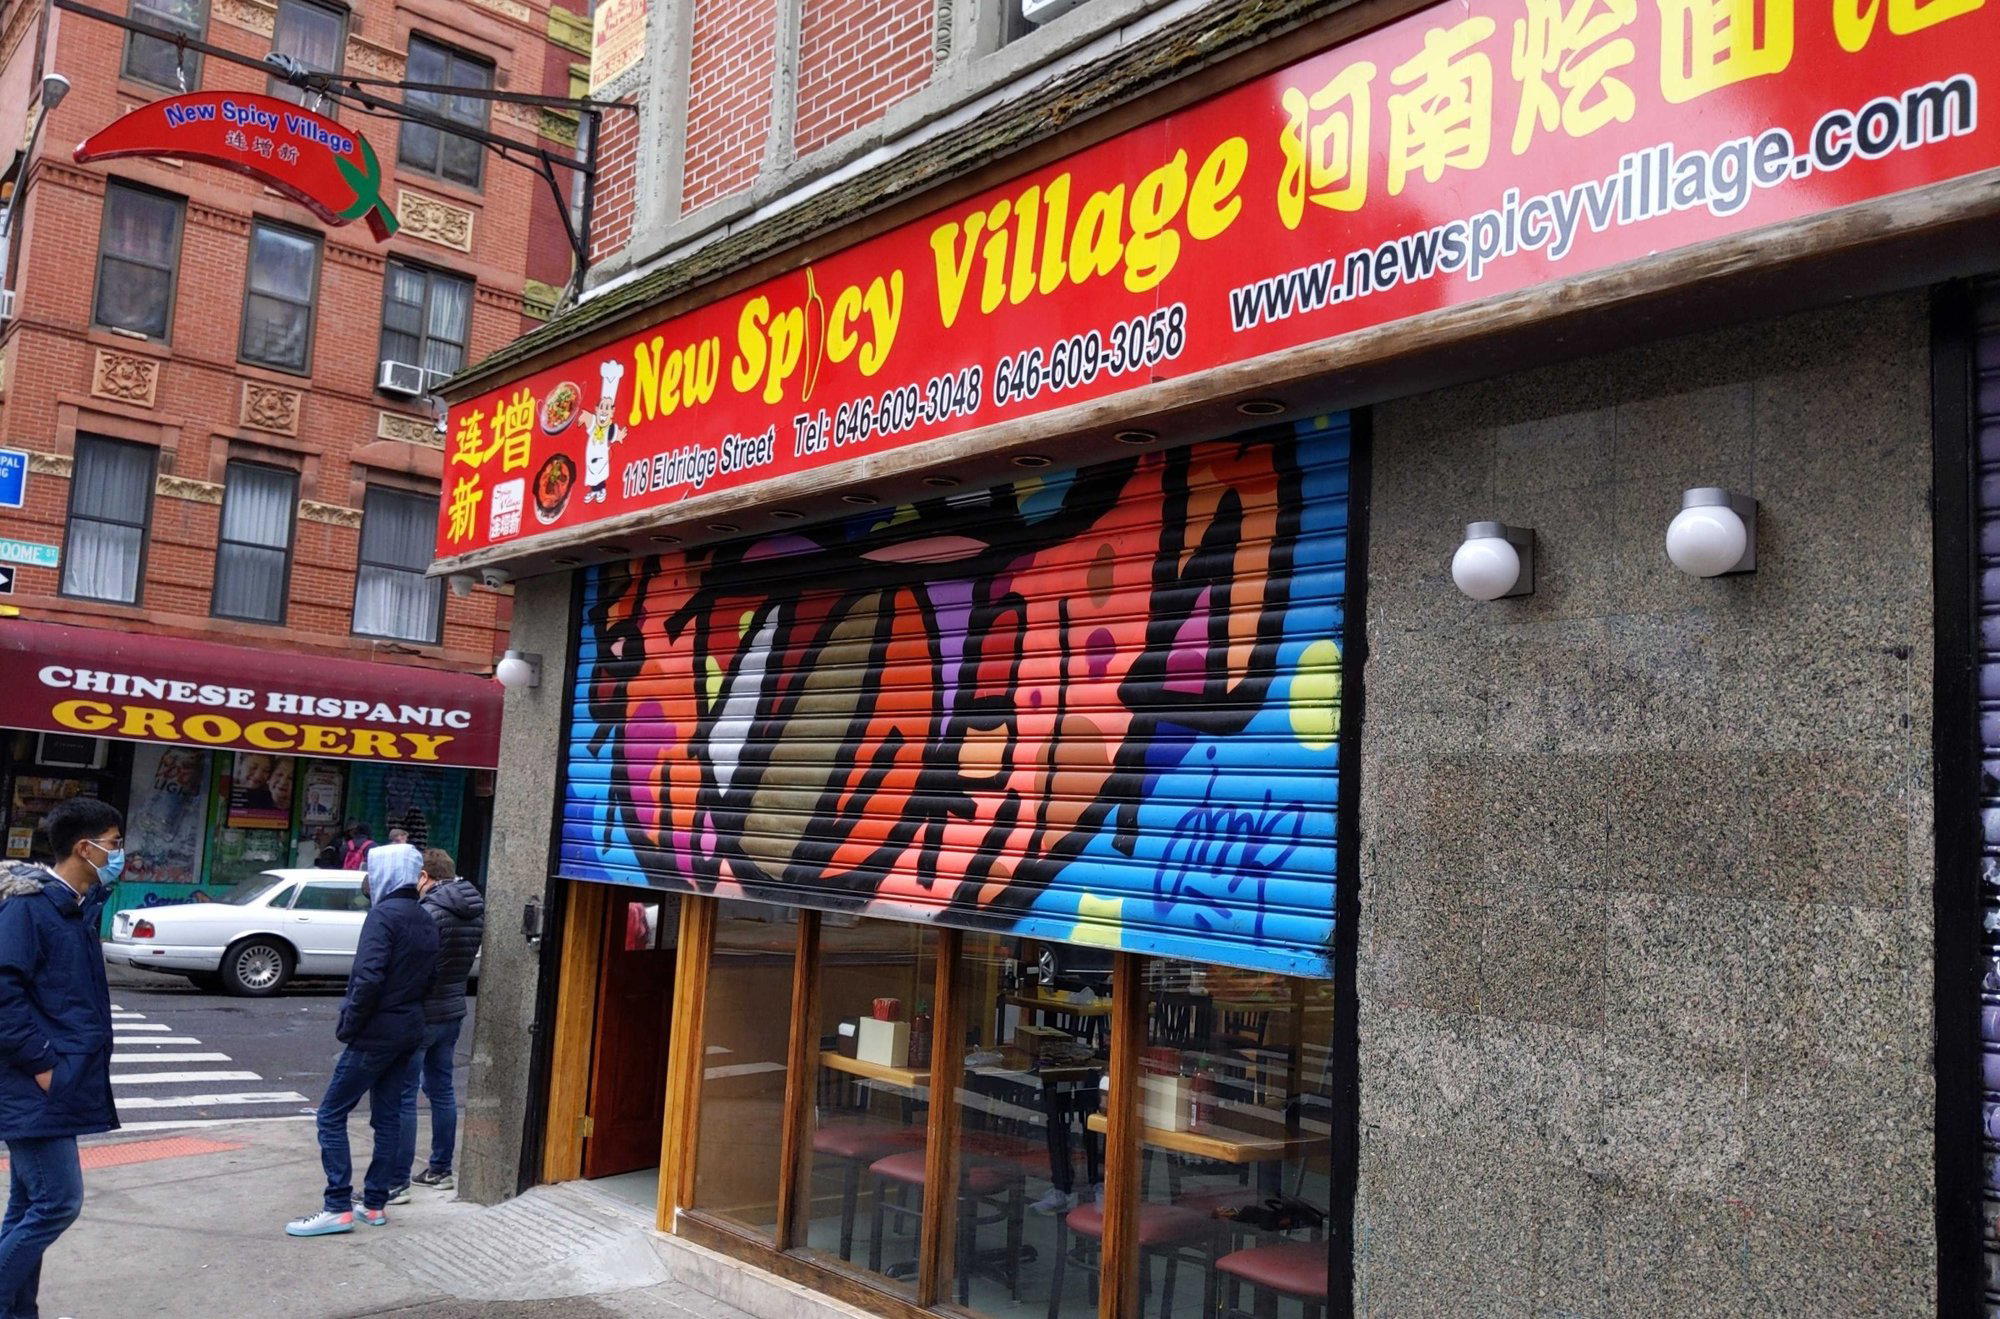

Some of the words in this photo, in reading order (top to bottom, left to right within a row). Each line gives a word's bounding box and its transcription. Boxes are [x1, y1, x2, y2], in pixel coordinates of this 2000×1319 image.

[165, 102, 216, 128] New
[222, 100, 280, 133] Spicy
[284, 112, 353, 153] Village
[1278, 0, 1986, 230] 河南烩面
[1229, 74, 1977, 331] www.newspicyvillage.com
[629, 335, 720, 427] New
[731, 267, 904, 405] Spicy
[930, 136, 1249, 329] Village
[623, 457, 649, 498] 118
[651, 444, 717, 491] Eldridge
[720, 425, 777, 474] Street
[794, 407, 829, 458] Tel:
[834, 365, 984, 446] 646-609-3048
[993, 302, 1187, 407] 646-609-3058
[0, 542, 43, 561] OOME
[47, 548, 56, 557] ST
[38, 665, 255, 710] CHINESE
[265, 691, 471, 729] HISPANIC
[51, 698, 455, 761] GROCERY
